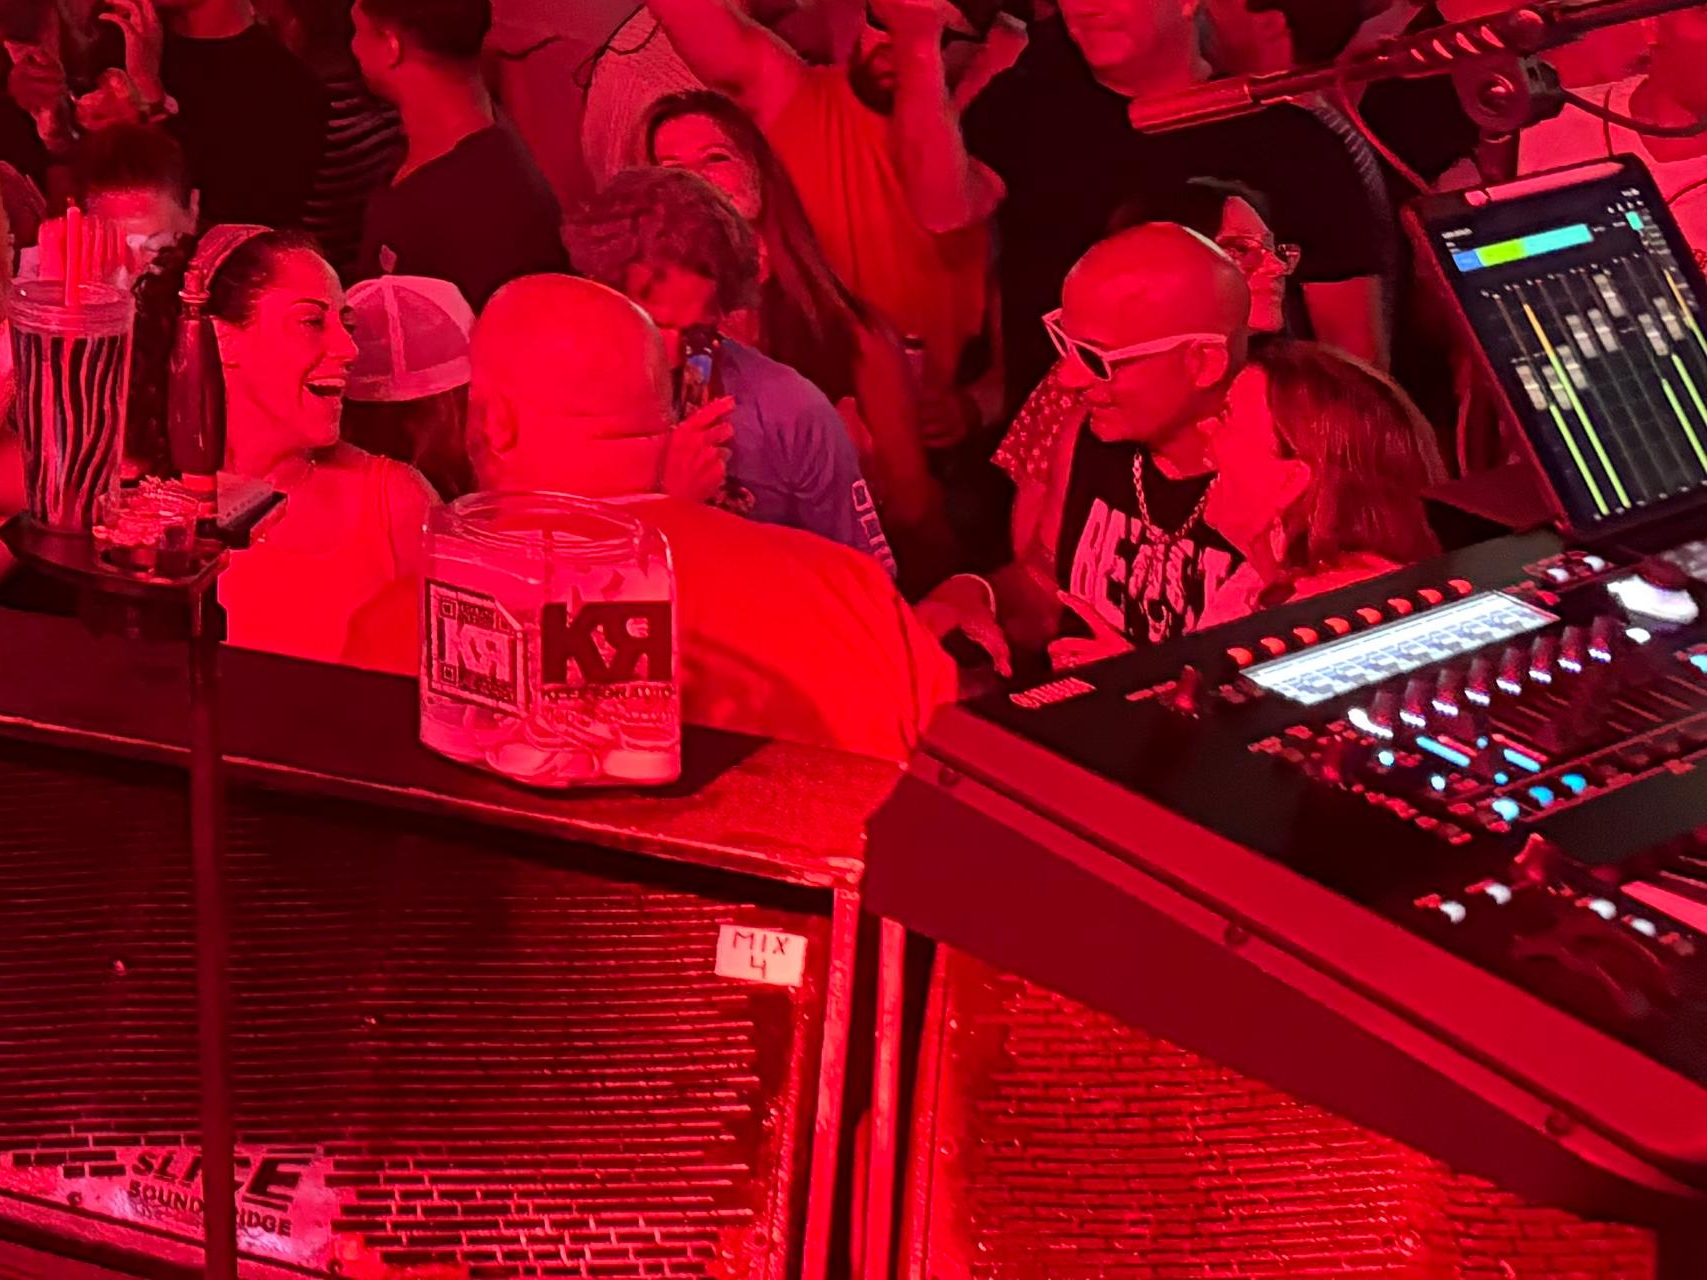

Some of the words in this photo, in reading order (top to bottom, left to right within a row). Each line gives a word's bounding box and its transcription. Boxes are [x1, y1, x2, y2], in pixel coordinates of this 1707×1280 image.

[733, 931, 790, 955] MIX
[750, 955, 767, 980] 4
[132, 1147, 318, 1212] SLIE
